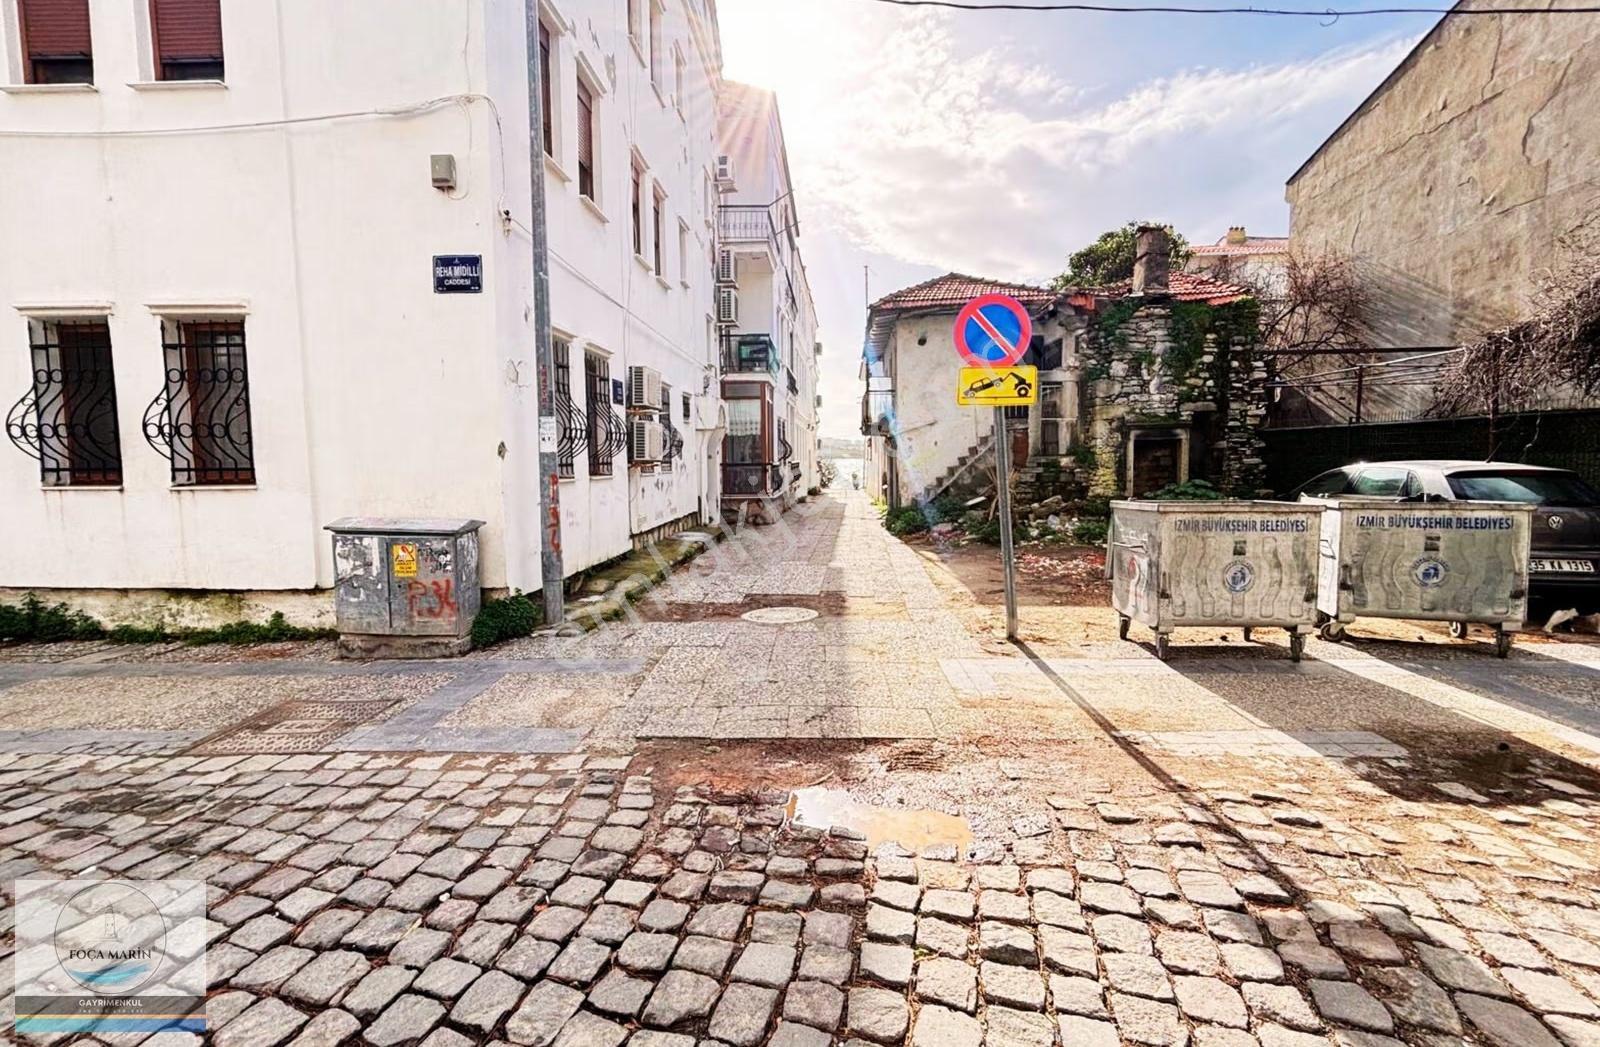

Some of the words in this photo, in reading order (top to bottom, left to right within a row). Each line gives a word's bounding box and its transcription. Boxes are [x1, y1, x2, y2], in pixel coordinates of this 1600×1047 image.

[436, 266, 453, 277] REHA
[444, 278, 471, 286] CADDESİ
[1174, 518, 1200, 532] İZMİR
[1201, 518, 1257, 534] BÜYÜKŞEHİR
[1259, 518, 1309, 532] BELEDİYESİ
[1356, 514, 1385, 528] İZMİR
[1388, 513, 1453, 531] BÜYÜKŞEHİR
[1455, 515, 1514, 530] BELEDİYESİ
[1531, 560, 1545, 570] 35
[1567, 560, 1592, 571] 1315
